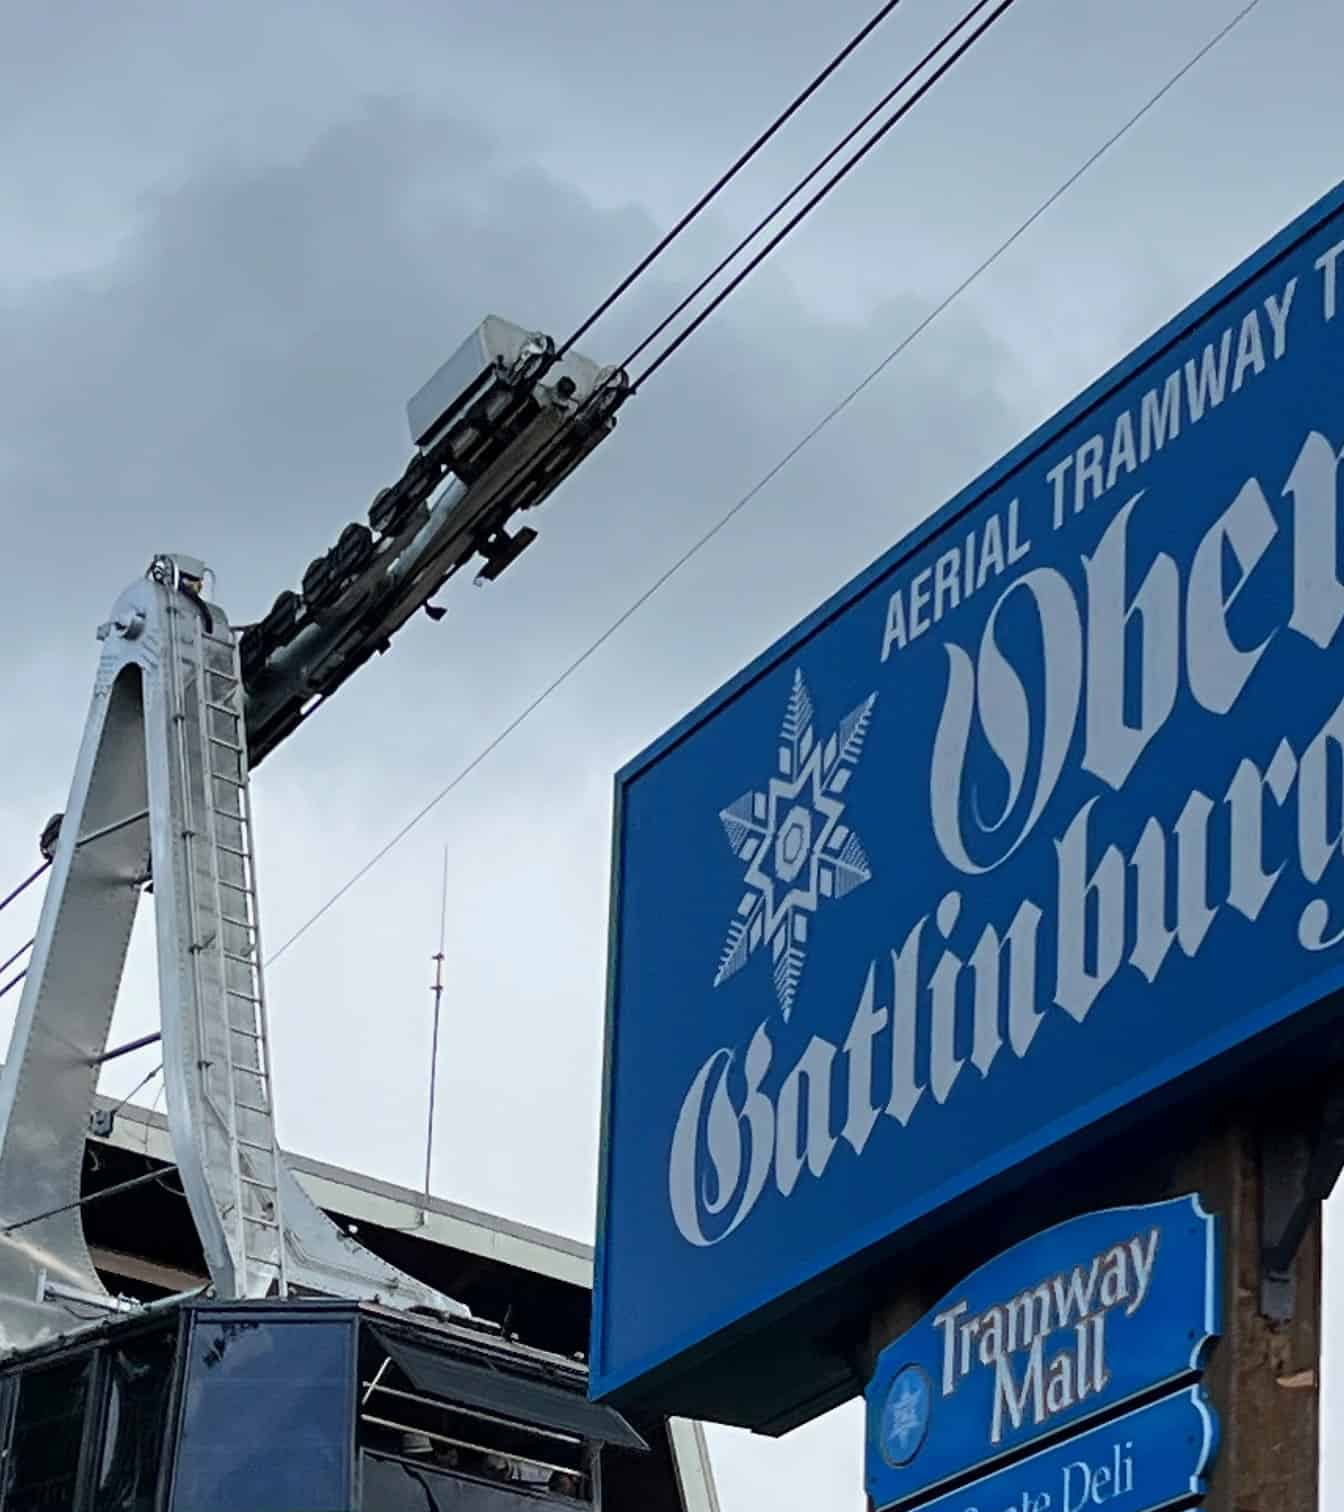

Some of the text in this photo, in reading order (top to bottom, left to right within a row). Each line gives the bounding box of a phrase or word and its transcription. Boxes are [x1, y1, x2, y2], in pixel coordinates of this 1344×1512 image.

[881, 497, 1030, 661] AERIAL
[1047, 278, 1296, 531] TRAMWAY
[933, 1227, 1159, 1397] Tramway
[990, 1309, 1110, 1445] Mall
